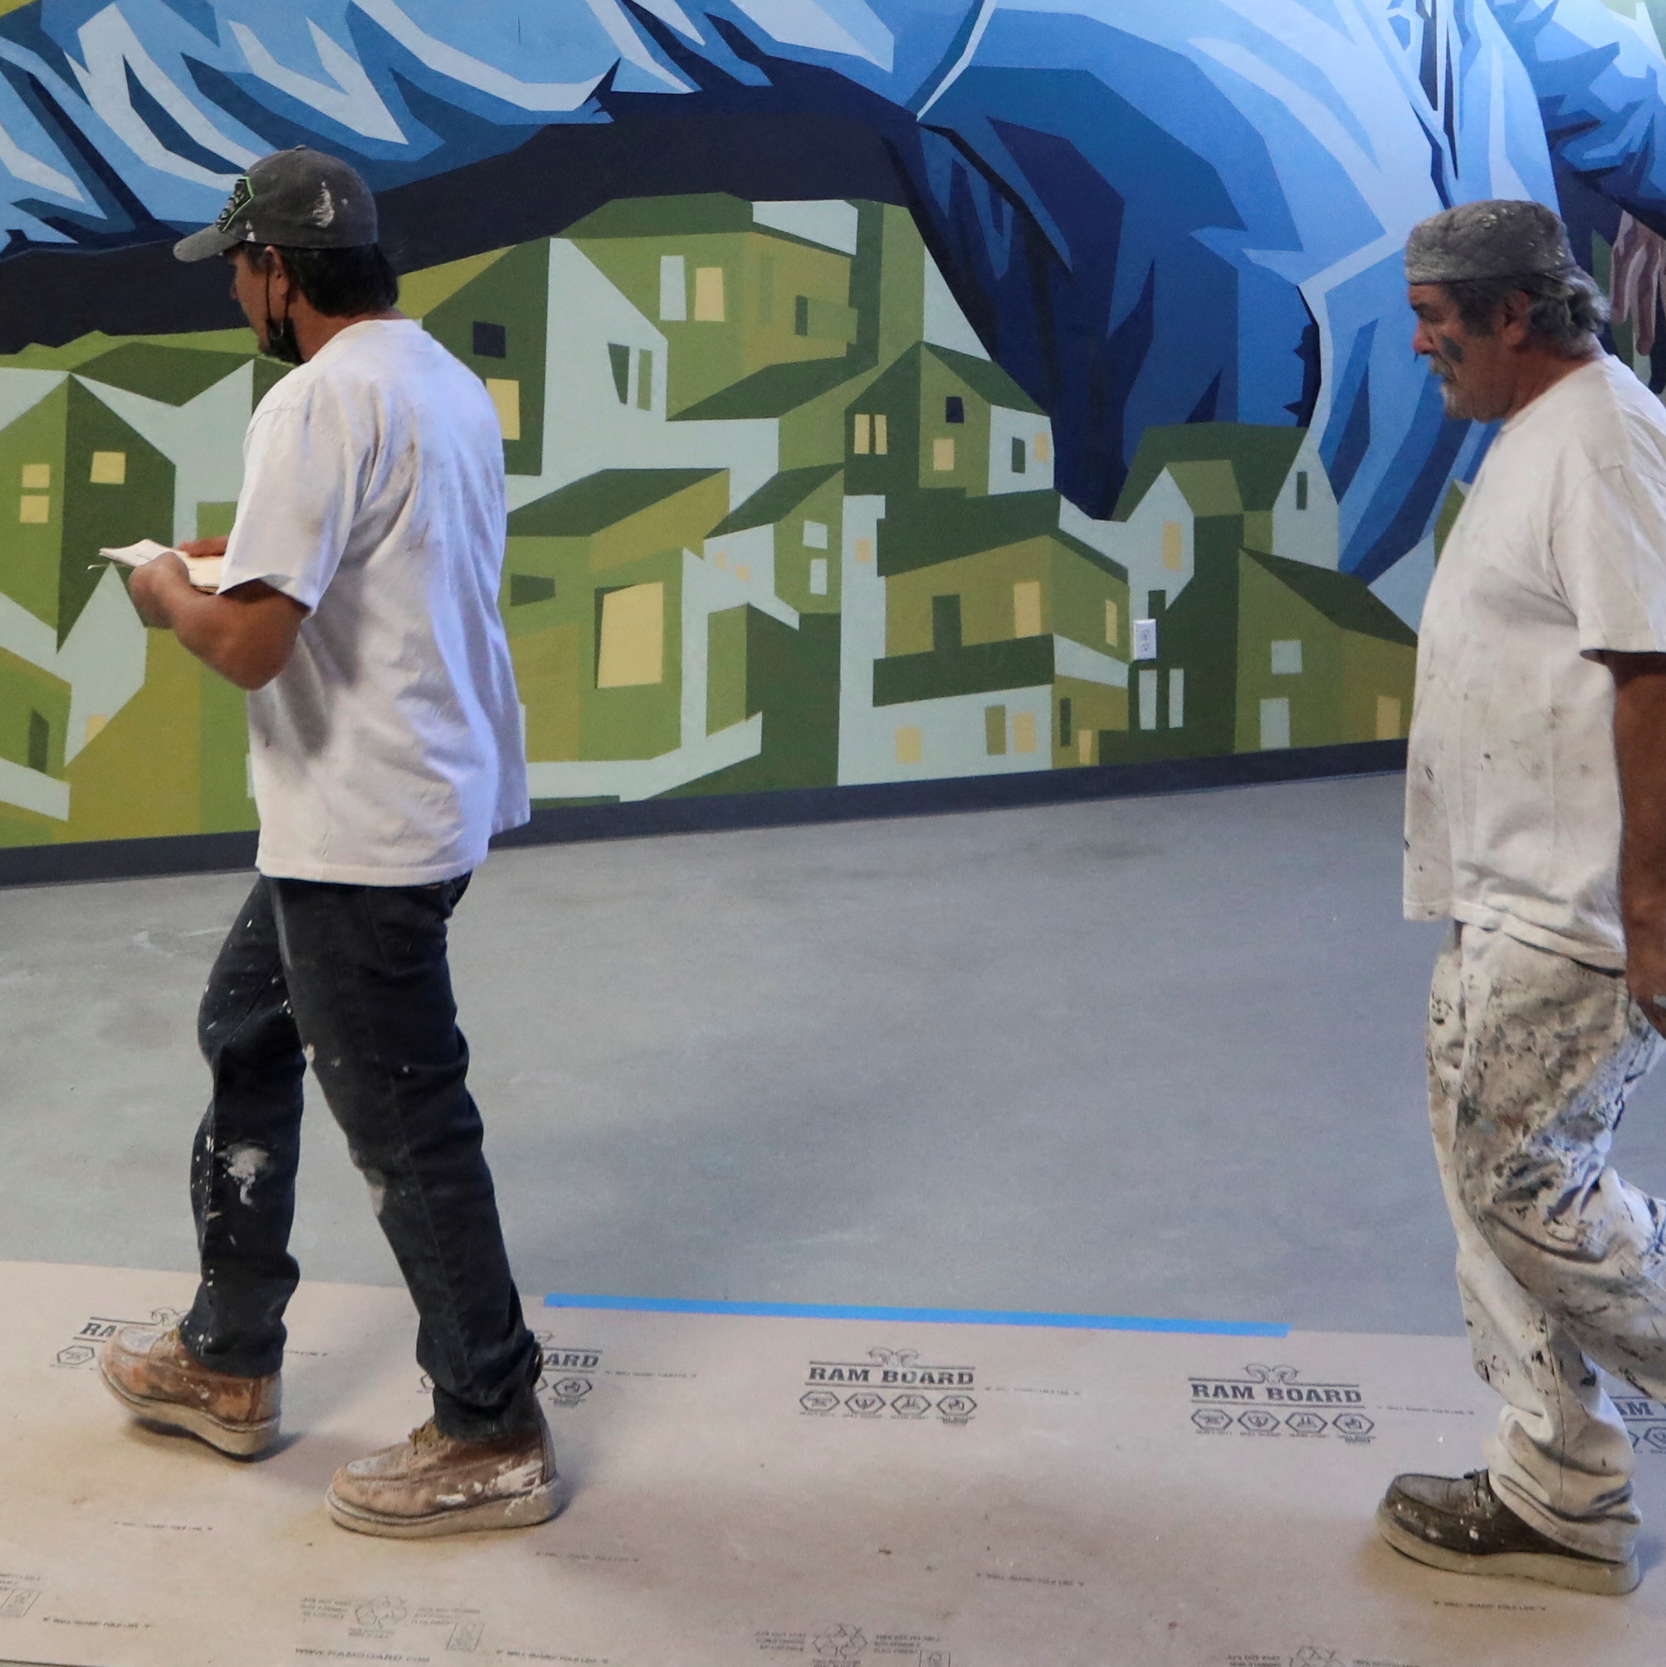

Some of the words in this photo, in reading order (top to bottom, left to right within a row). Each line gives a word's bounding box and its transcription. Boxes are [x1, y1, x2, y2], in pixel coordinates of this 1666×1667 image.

[80, 1323, 117, 1337] RA
[543, 1352, 600, 1368] ARD
[808, 1367, 870, 1382] RAM
[882, 1370, 974, 1384] BOARD
[1191, 1384, 1255, 1400] RAM
[1266, 1387, 1362, 1403] BOARD
[1613, 1402, 1654, 1415] AM
